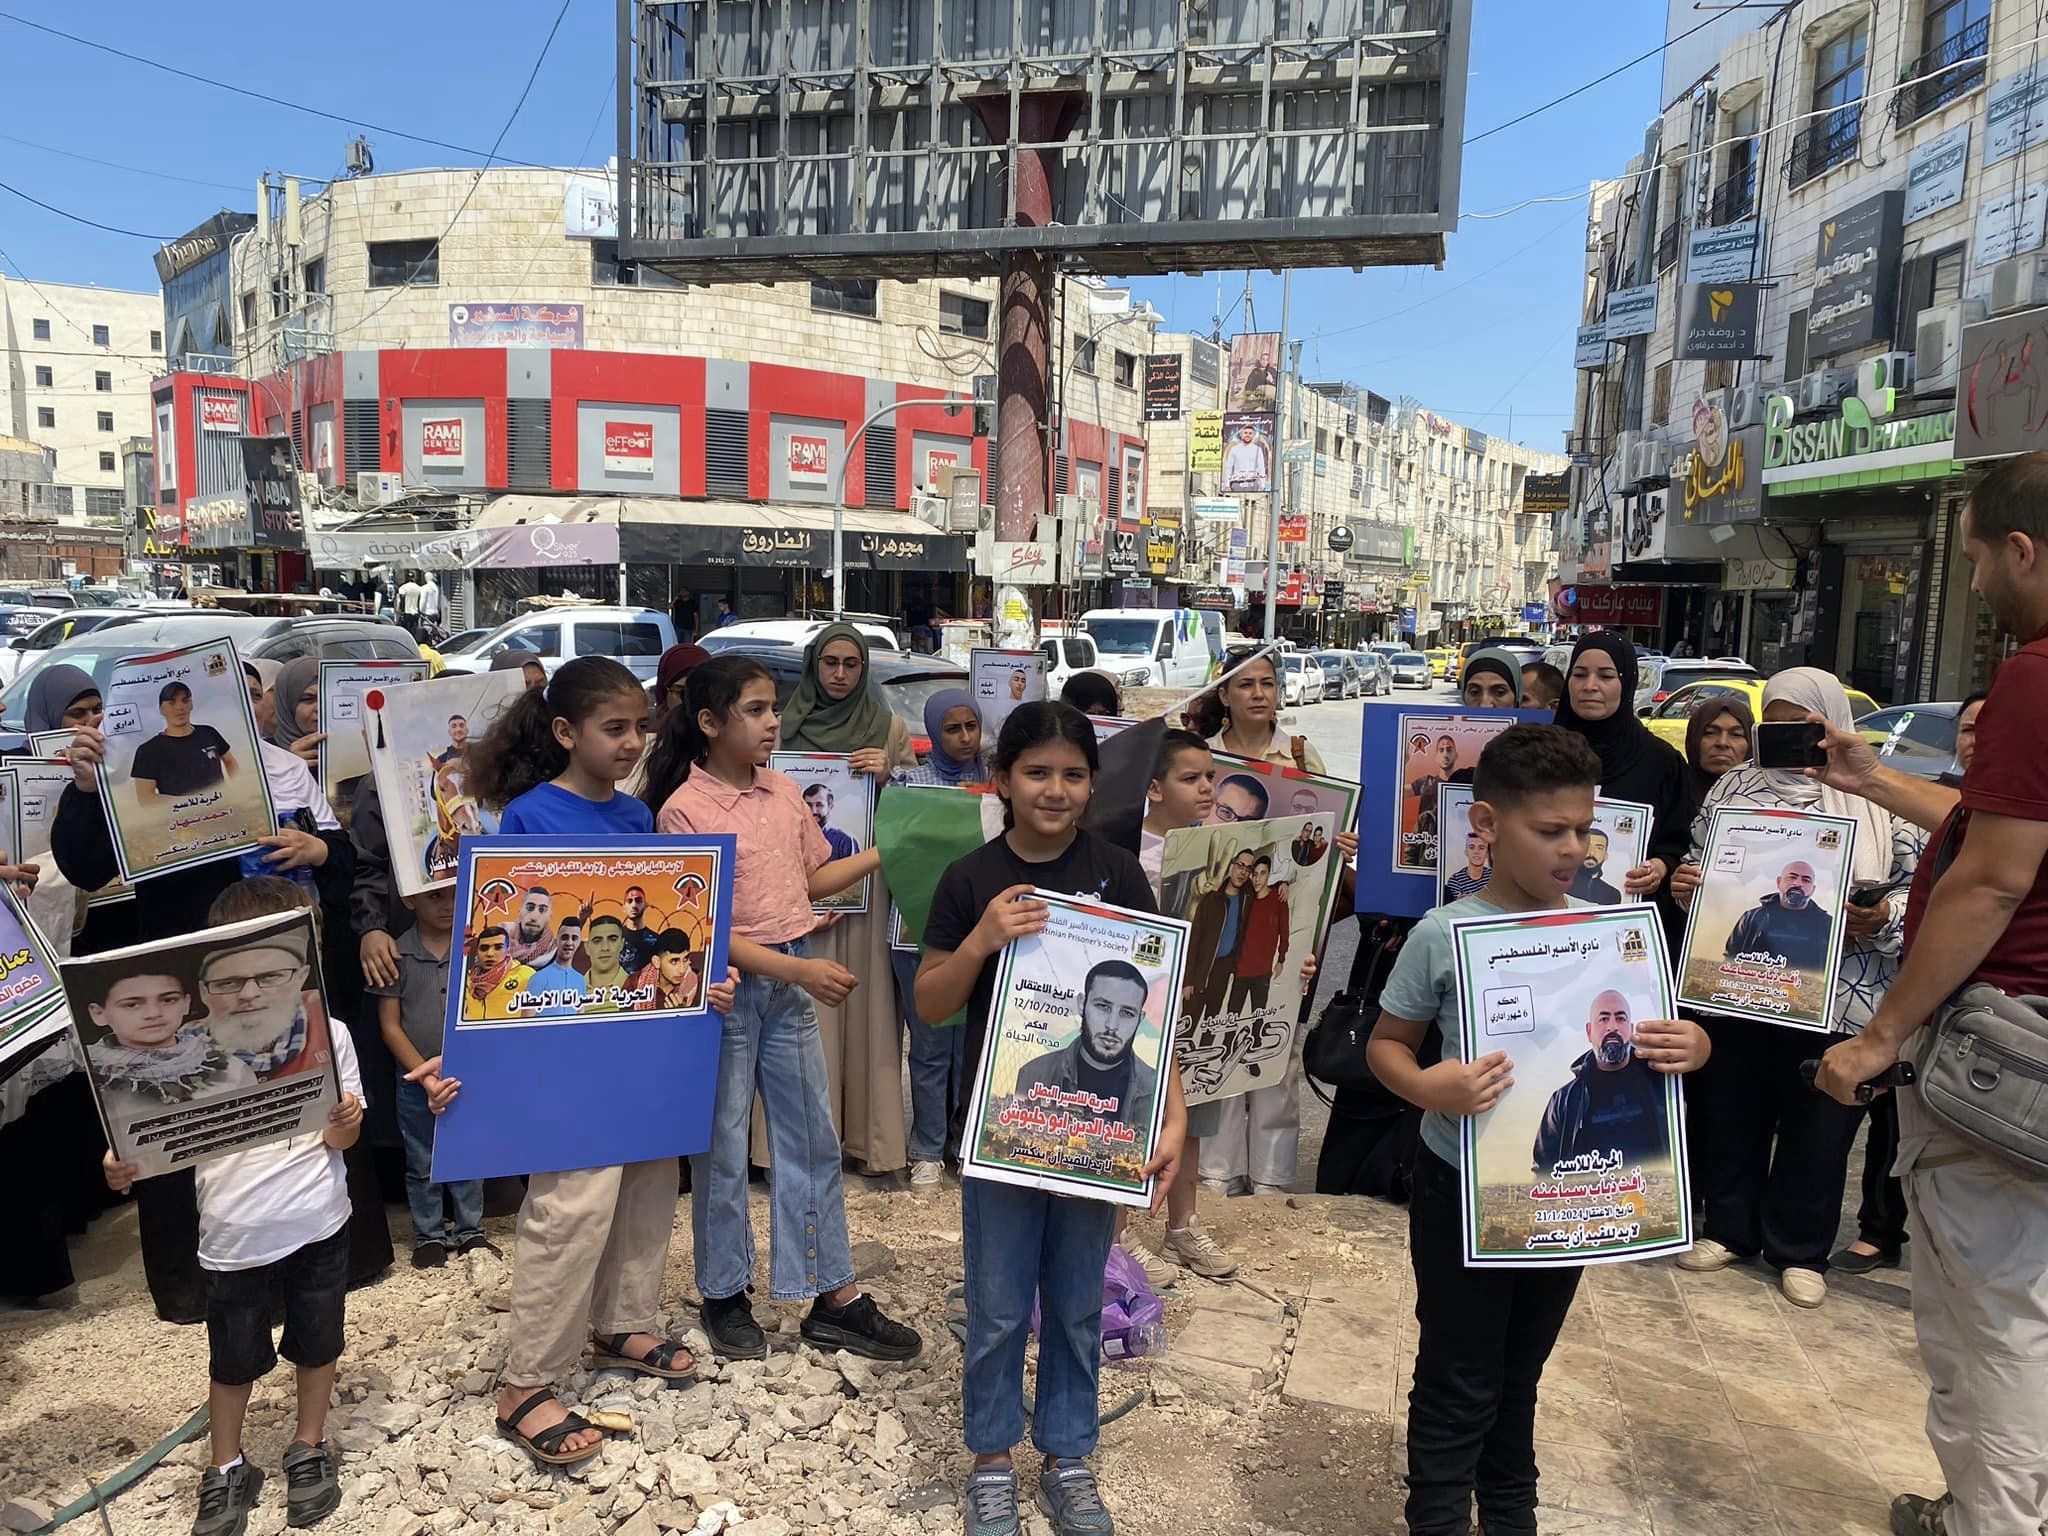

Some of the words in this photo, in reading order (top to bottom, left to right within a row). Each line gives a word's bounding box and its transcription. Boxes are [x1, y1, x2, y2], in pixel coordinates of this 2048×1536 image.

[471, 306, 521, 326] السفير
[523, 306, 579, 325] شركة
[1688, 328, 1707, 339] جرار
[1707, 328, 1735, 339] روضة
[1150, 357, 1178, 370] مكتب
[1147, 384, 1179, 396] الهندسي
[204, 402, 238, 413] RAMI
[424, 424, 461, 439] RAMI
[1195, 427, 1219, 439] لثقة
[1763, 396, 1846, 468] BISSAN
[1873, 410, 1955, 452] PHARMAC
[424, 439, 461, 448] CENTER
[792, 442, 826, 458] RAMI
[1192, 444, 1221, 456] لهندسي
[264, 510, 303, 532] STORE
[742, 529, 811, 553] الفاروق
[861, 535, 924, 558] مجوهرات
[1011, 545, 1043, 575] Sky
[151, 666, 176, 684] الأسير
[175, 668, 191, 681] نادي
[336, 675, 373, 686] الفلسطيني
[113, 719, 135, 731] اداري
[1727, 824, 1766, 835] الفلسطيني
[1767, 825, 1788, 838] الأسير
[1787, 828, 1802, 841] نادي
[508, 861, 546, 878] ينكسر
[646, 860, 665, 875] لليل
[1069, 920, 1088, 932] الأسير
[1089, 925, 1107, 936] نادي
[1068, 932, 1102, 946] Prisoner's
[1103, 941, 1128, 954] Society
[1553, 936, 1581, 958] الأسير
[1580, 937, 1600, 960] نادي
[1487, 941, 1554, 969] الفلسطيني
[1763, 952, 1788, 969] الحرية
[14, 974, 41, 996] عضو
[1015, 978, 1052, 994] الاعتقال
[1053, 987, 1075, 1000] تاريخ
[507, 988, 559, 1012] الابطال
[560, 986, 607, 1009] لاسرانا
[610, 984, 655, 1007] الحرية
[1496, 996, 1520, 1007] الحكم
[1014, 998, 1070, 1017] 12/10/2002
[1506, 1010, 1523, 1022] شهور
[1523, 1009, 1529, 1018] 6
[1490, 1011, 1507, 1024] اداري
[1005, 1028, 1034, 1043] الحياة
[1028, 1082, 1059, 1101] البطل
[1087, 1096, 1118, 1113] الحرية
[999, 1101, 1047, 1133] جلبوش
[1048, 1112, 1070, 1135] ابو
[1069, 1119, 1103, 1139] الدين
[1104, 1123, 1136, 1144] صلاح
[1010, 1145, 1046, 1162] ينكسر
[1062, 1153, 1090, 1170] للقيد
[1591, 1149, 1623, 1175] الحرية
[1090, 1158, 1104, 1174] بد
[1104, 1160, 1112, 1172] لا
[1589, 1173, 1617, 1202] ذياب
[1618, 1166, 1647, 1195] رأفت
[1530, 1181, 1588, 1203] سباعنه
[1615, 1202, 1634, 1219] تاريخ
[1572, 1228, 1584, 1246] أن
[1585, 1227, 1617, 1244] للقيد
[1618, 1227, 1631, 1242] بد
[1630, 1224, 1639, 1236] لا
[1527, 1232, 1570, 1248] ينكسر
